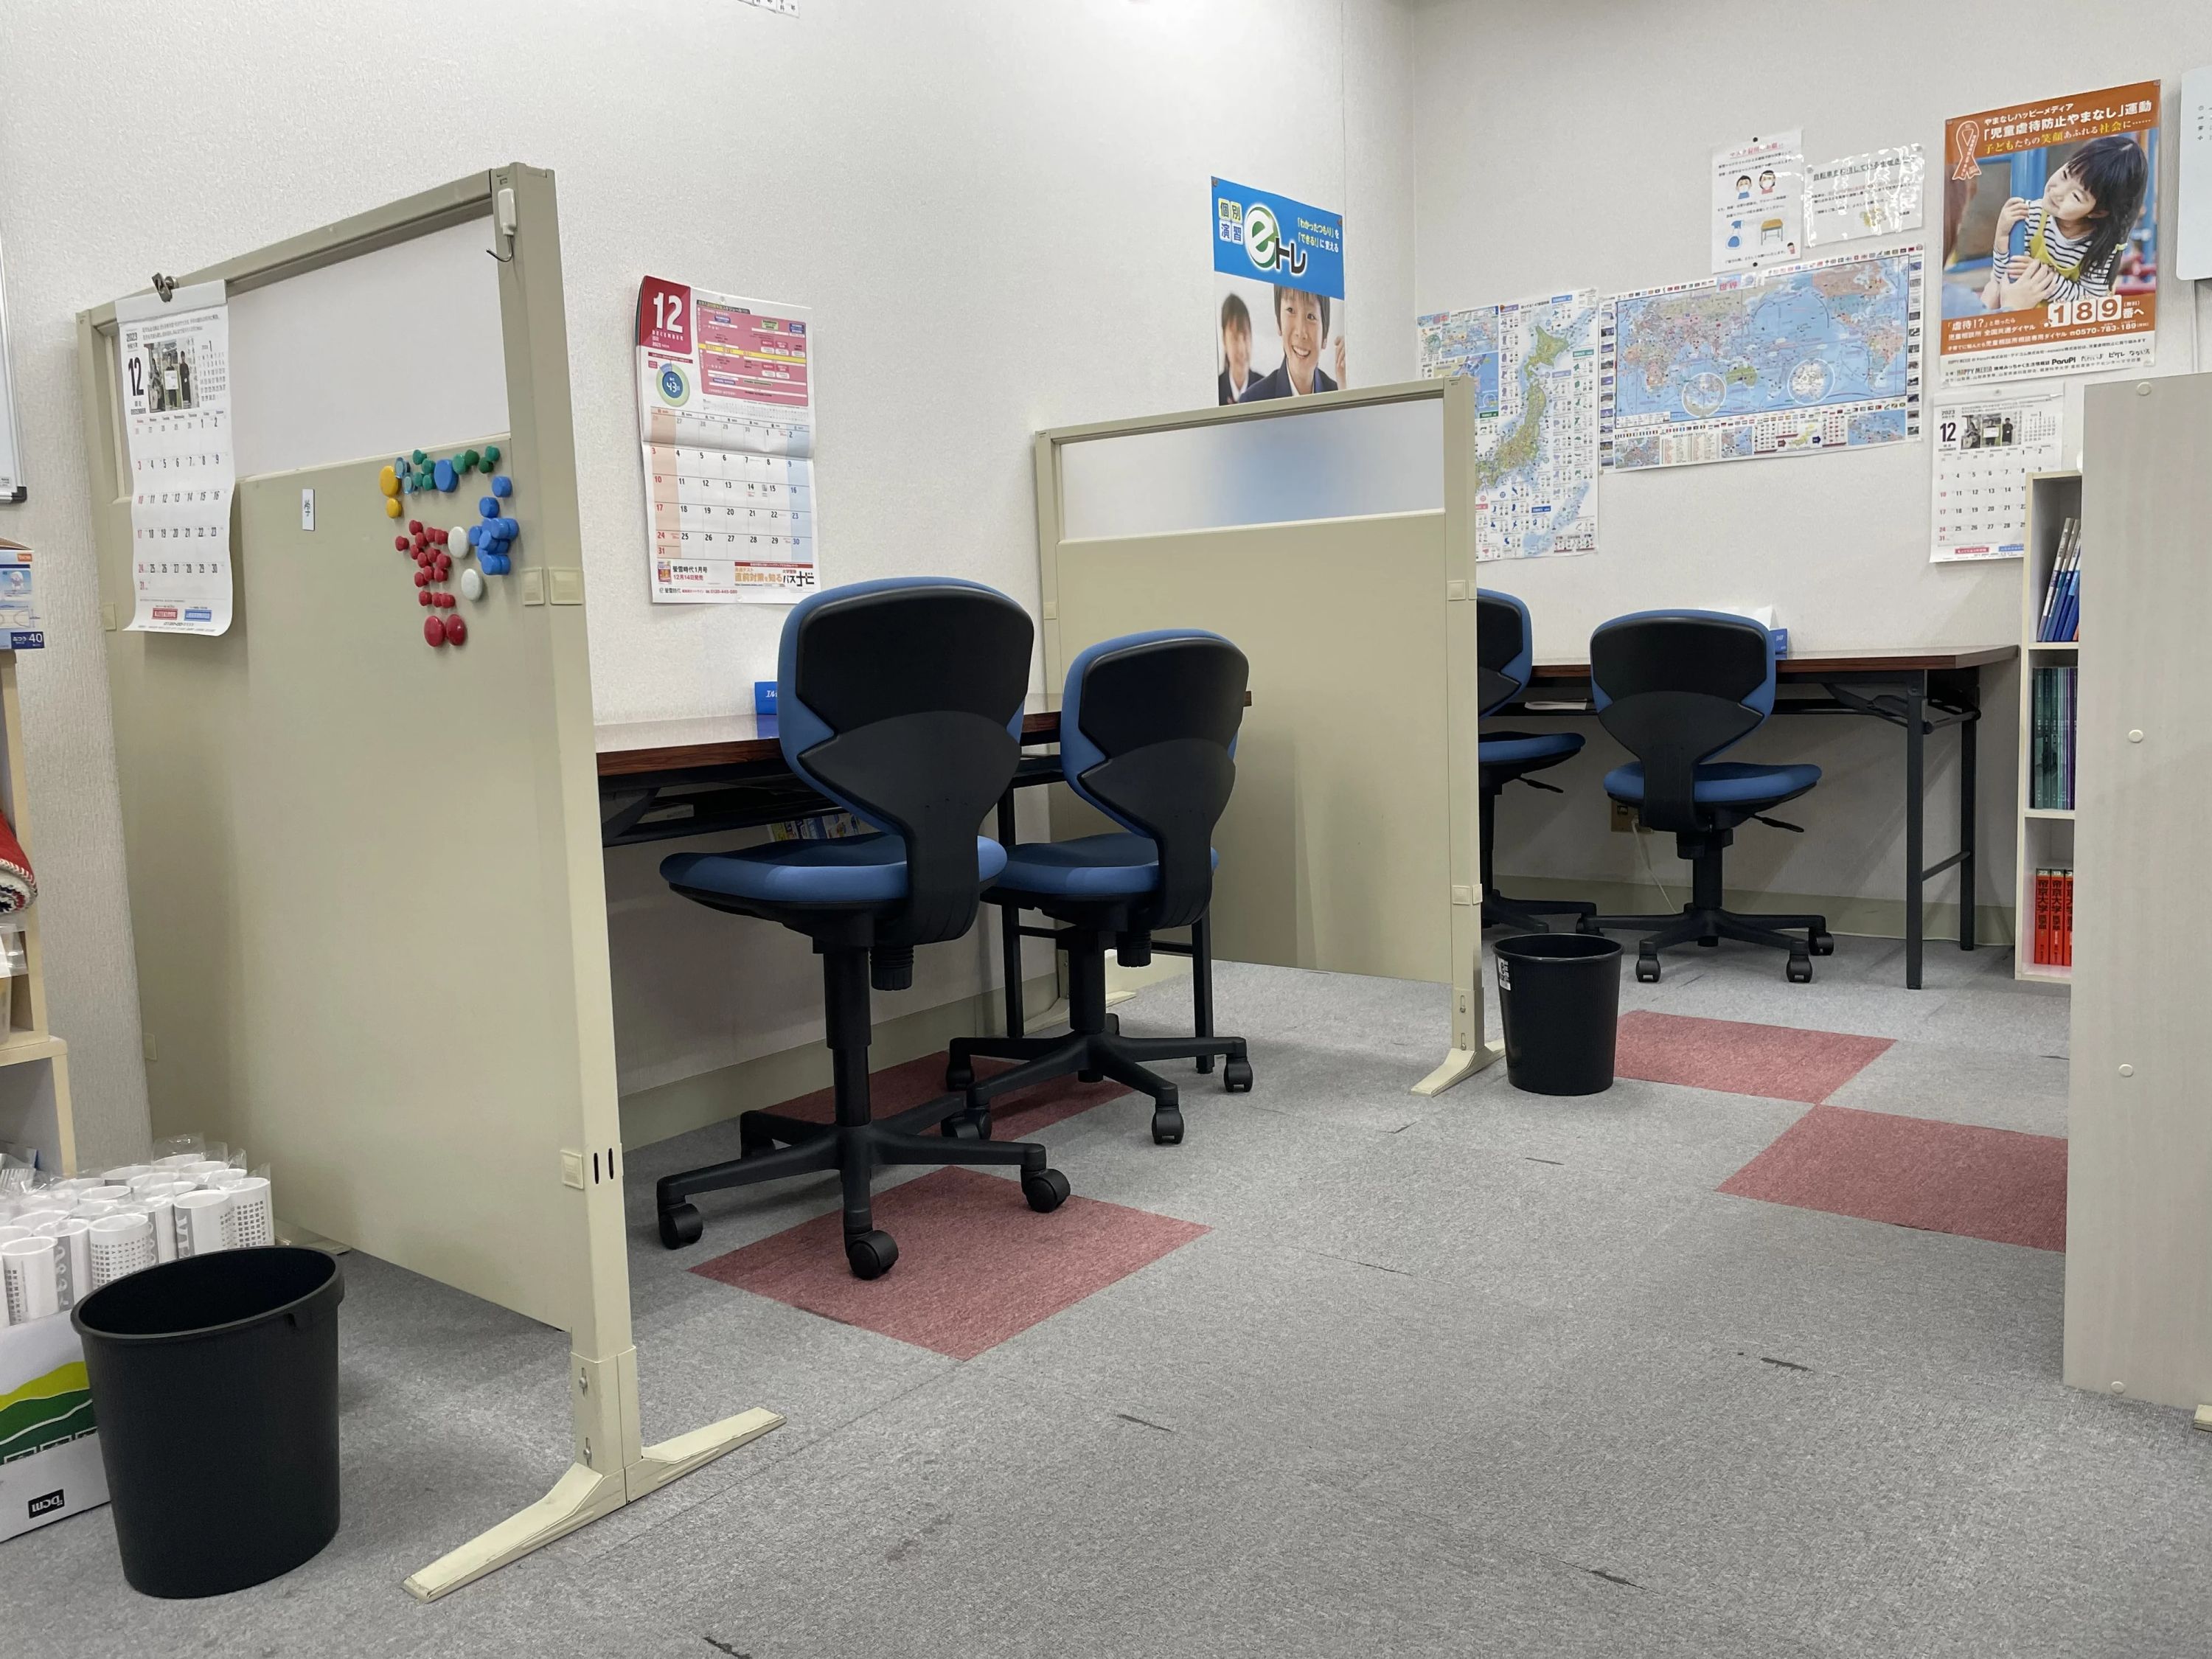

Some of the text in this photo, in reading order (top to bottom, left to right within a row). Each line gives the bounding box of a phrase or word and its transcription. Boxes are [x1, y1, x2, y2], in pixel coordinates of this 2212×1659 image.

[1983, 100, 2152, 141] 「児童虐待防止やまなし」運動
[1984, 103, 2074, 125] やまなしハッピーメディア
[1221, 201, 1241, 221] 個別
[1221, 223, 1242, 242] 演習
[1298, 218, 1340, 239] 「わかったつもり」を
[653, 292, 683, 333] 12
[2053, 299, 2118, 324] 189
[2123, 307, 2145, 319] 番へ
[652, 330, 684, 341] DECEMBER
[1948, 324, 2036, 341] 児童相談所 全国共通ダイヤル
[2052, 356, 2076, 365] ParuPi
[128, 357, 144, 397] 12
[201, 419, 204, 428] 1
[214, 417, 218, 428] 2
[1940, 422, 1956, 442] 12
[137, 454, 219, 470] 3 4 5 6 7 8 9
[138, 490, 220, 504] 10 11 12 13 14 15 16
[138, 526, 217, 538] 17 18 19 20 21 22 23
[139, 563, 218, 573] 24 25 26 27 28 29 30
[139, 581, 145, 590] 31
[673, 574, 704, 582] 12月14日発売
[783, 570, 815, 587] パスナビ
[29, 633, 43, 643] 40
[2037, 880, 2049, 913] 帝京大学
[2051, 880, 2062, 912] 帝京大学
